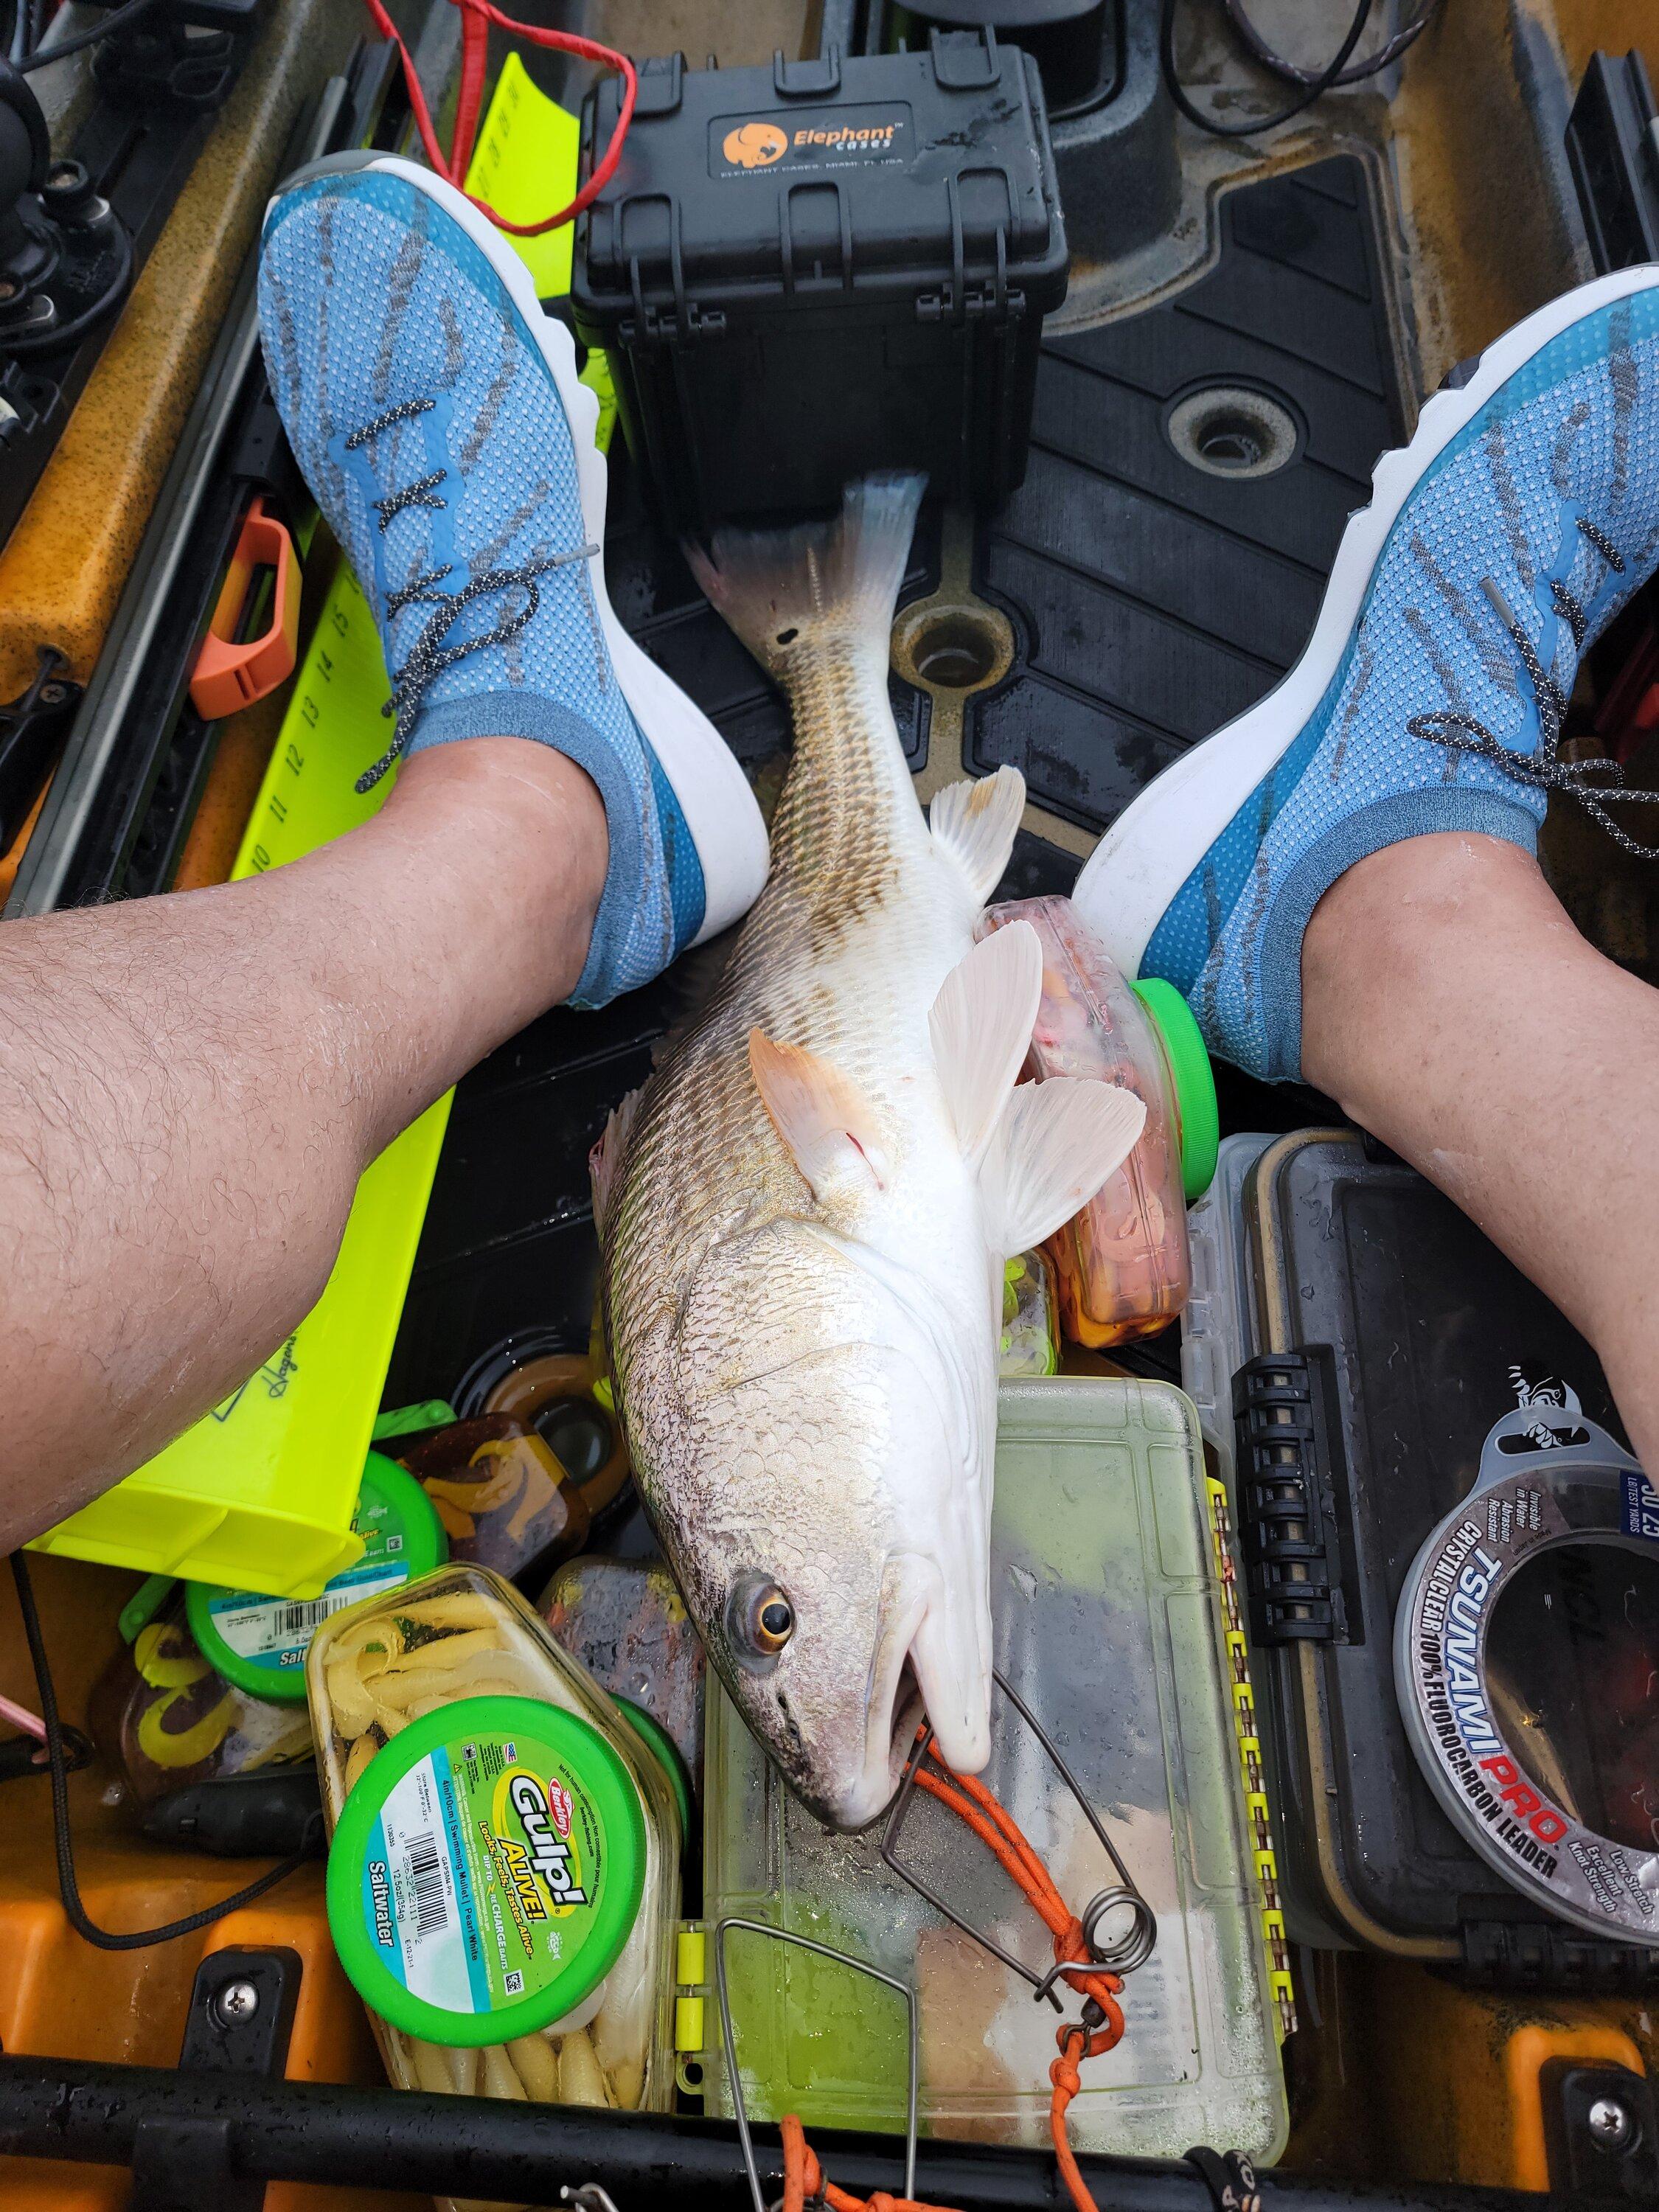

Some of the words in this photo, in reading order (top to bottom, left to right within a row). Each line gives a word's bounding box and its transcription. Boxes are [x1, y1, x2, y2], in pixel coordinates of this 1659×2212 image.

[794, 125, 894, 146] Elephant
[836, 139, 891, 151] cases
[333, 604, 349, 637] 15
[317, 650, 333, 683] 14
[302, 695, 319, 728] 13
[286, 744, 304, 776] 12
[270, 795, 288, 824] 11
[252, 844, 271, 873] 10
[1516, 1488, 1528, 1498] in
[1627, 1477, 1638, 1507] LB/TEST
[1488, 1498, 1500, 1543] Resistant
[1501, 1500, 1513, 1543] Abrasion
[1516, 1500, 1528, 1528] Water
[1529, 1491, 1542, 1531] Invisible
[1629, 1509, 1640, 1533] YARDS
[1433, 1520, 1483, 1583] CRYSTAL
[1421, 1579, 1450, 1632] CLEAR
[1419, 1633, 1442, 1680] 100%
[1443, 1546, 1505, 1754] TSUNAMI
[1478, 1754, 1570, 1843] PRO
[557, 1763, 567, 1774] Not
[1424, 1681, 1502, 1823] FLUOROCARBON
[563, 1770, 571, 1778] for
[568, 1776, 581, 1794] human
[423, 1788, 432, 1812] Between
[441, 1778, 455, 1818] 4in/10cm
[550, 1785, 568, 1831] Berkley
[579, 1793, 597, 1825] consumption
[450, 1824, 464, 1870] Swimming
[509, 1776, 588, 1906] Gulp!
[579, 1806, 594, 1857] berkley-fishing.com
[1495, 1817, 1559, 1879] LEADER
[402, 1855, 414, 1886] 28632
[440, 1856, 452, 1896] GAPSM4-PW
[482, 1854, 491, 1868] DIP
[484, 1870, 493, 1881] TO
[1568, 1842, 1591, 1868] Knot
[1584, 1867, 1618, 1913] Strength
[1586, 1846, 1623, 1896] Excellent
[386, 1823, 395, 1847] 1130355
[404, 1938, 414, 1967] E-12-21-1
[458, 1871, 469, 1899] Mullet
[479, 1820, 495, 1855] Looks,
[493, 1856, 509, 1888] Feels,
[506, 1888, 523, 1924] Tastes
[517, 1924, 534, 1955] Alive
[498, 1839, 546, 1920] ALIVE!
[587, 1884, 599, 1908] humains
[1610, 1851, 1630, 1874] Low
[1624, 1875, 1655, 1915] Stretch
[368, 1860, 394, 1948] Saltwater
[407, 1891, 417, 1921] 22111
[464, 1907, 475, 1933] Pearl
[468, 1933, 479, 1961] White
